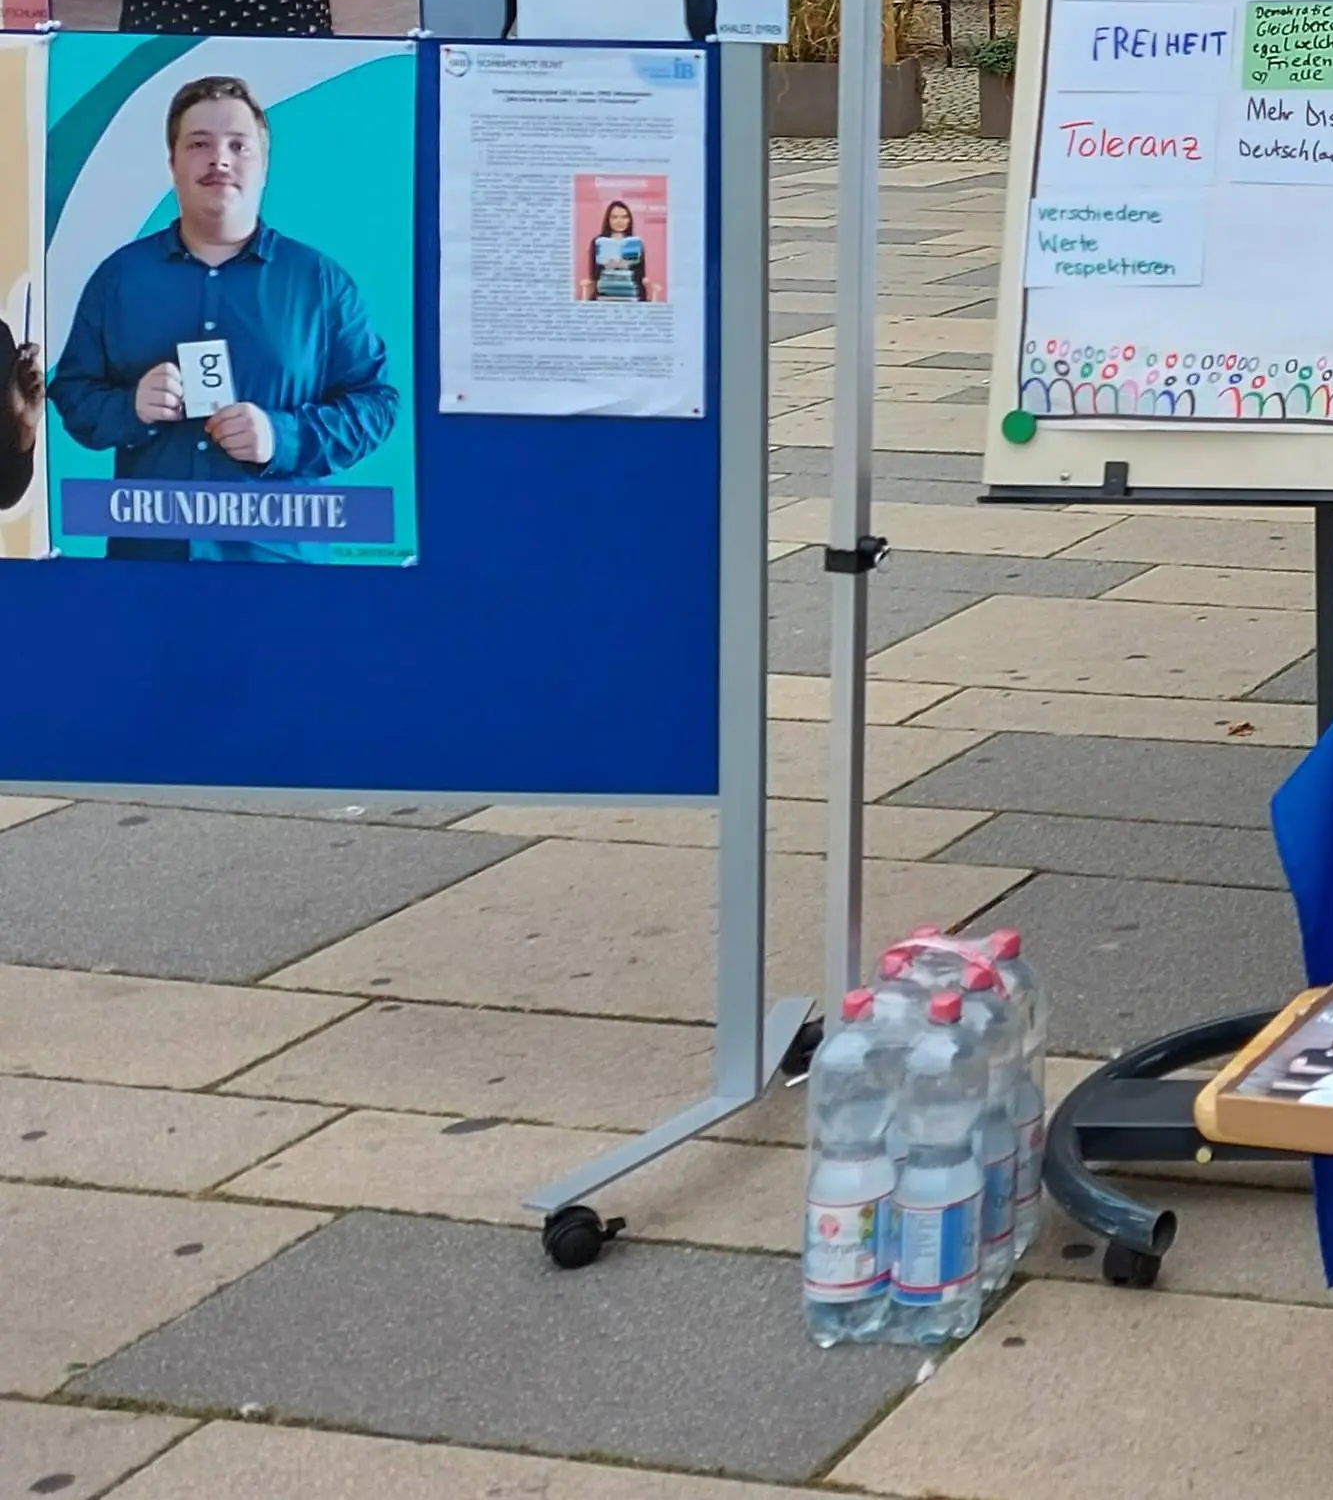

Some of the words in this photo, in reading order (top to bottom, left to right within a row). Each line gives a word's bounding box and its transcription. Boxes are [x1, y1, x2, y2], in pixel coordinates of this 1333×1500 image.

[1093, 26, 1227, 61] FREIHEIT
[1248, 97, 1293, 121] Mehr
[1060, 122, 1201, 160] Toleranz
[1039, 205, 1162, 223] verschiedene
[1039, 232, 1098, 253] Werte
[1056, 258, 1175, 277] respektieren
[200, 353, 222, 388] g
[110, 488, 347, 530] GRUNDRECHTE
